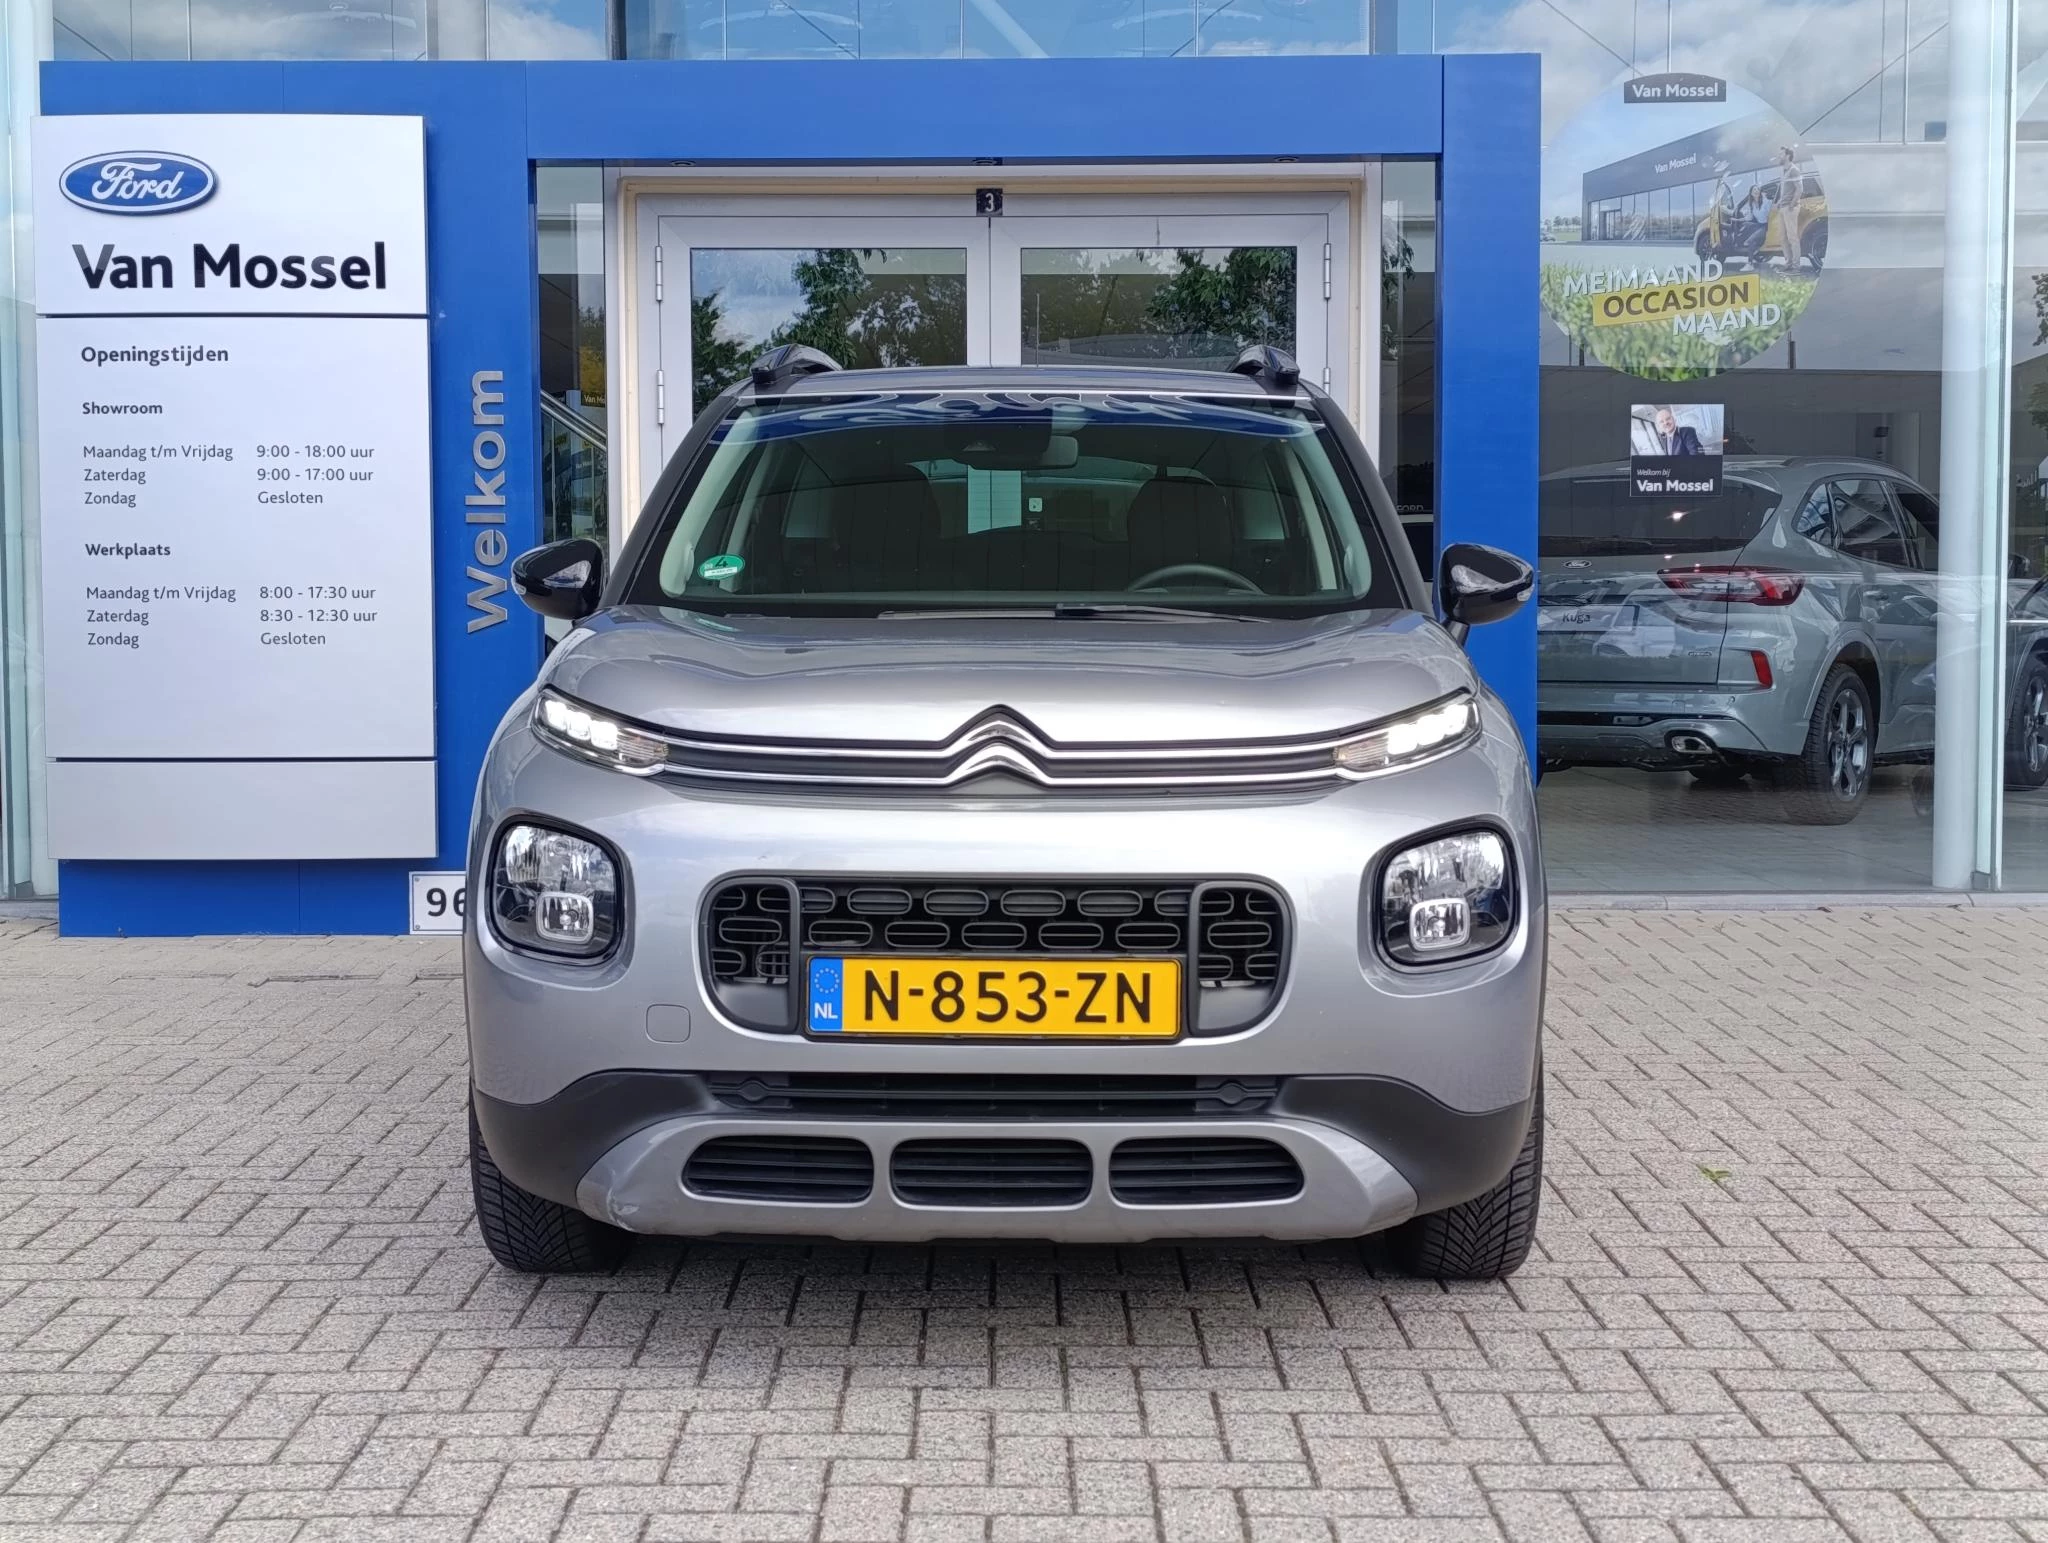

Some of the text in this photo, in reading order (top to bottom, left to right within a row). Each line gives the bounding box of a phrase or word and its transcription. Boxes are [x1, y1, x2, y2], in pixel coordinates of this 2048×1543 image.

[1632, 82, 1718, 98] Van Mossel
[1654, 152, 1697, 174] Van Mossel
[91, 161, 183, 201] Ford
[985, 192, 994, 212] 3
[71, 241, 387, 290] Van Mossel
[1563, 258, 1724, 297] MEIMAAND
[1602, 280, 1750, 319] OCCASION
[1672, 303, 1782, 336] MAAND
[81, 344, 229, 367] Openingstijden
[82, 401, 163, 415] Showroom
[83, 444, 147, 462] Maandag
[150, 444, 177, 459] t/m
[181, 443, 234, 462] Vrijdag
[256, 444, 290, 458] 9:00
[304, 444, 346, 458] 18:00
[350, 448, 375, 459] uur
[84, 467, 147, 485] Zaterdag
[257, 467, 291, 481] 9:00
[304, 467, 345, 481] 17:00
[349, 471, 374, 481] uur
[1636, 478, 1714, 492] Van Mossel
[84, 491, 324, 508] Zondag Gesloten
[464, 370, 508, 634] Welkom
[85, 542, 171, 560] Werkplaats
[86, 585, 150, 604] Maandag
[153, 585, 180, 600] t/m
[184, 585, 237, 604] Vrijdag
[259, 586, 293, 599] 8:00
[307, 585, 347, 599] 17:30
[351, 589, 377, 599] uur
[86, 608, 150, 627] Zaterdag
[260, 609, 294, 622] 8:30
[307, 609, 349, 622] 12:30
[353, 612, 378, 622] uur
[1562, 612, 1591, 624] Kuga
[87, 631, 326, 649] Zondag Gesloten
[864, 969, 1151, 1024] N-853-ZN
[814, 1003, 838, 1020] NL
